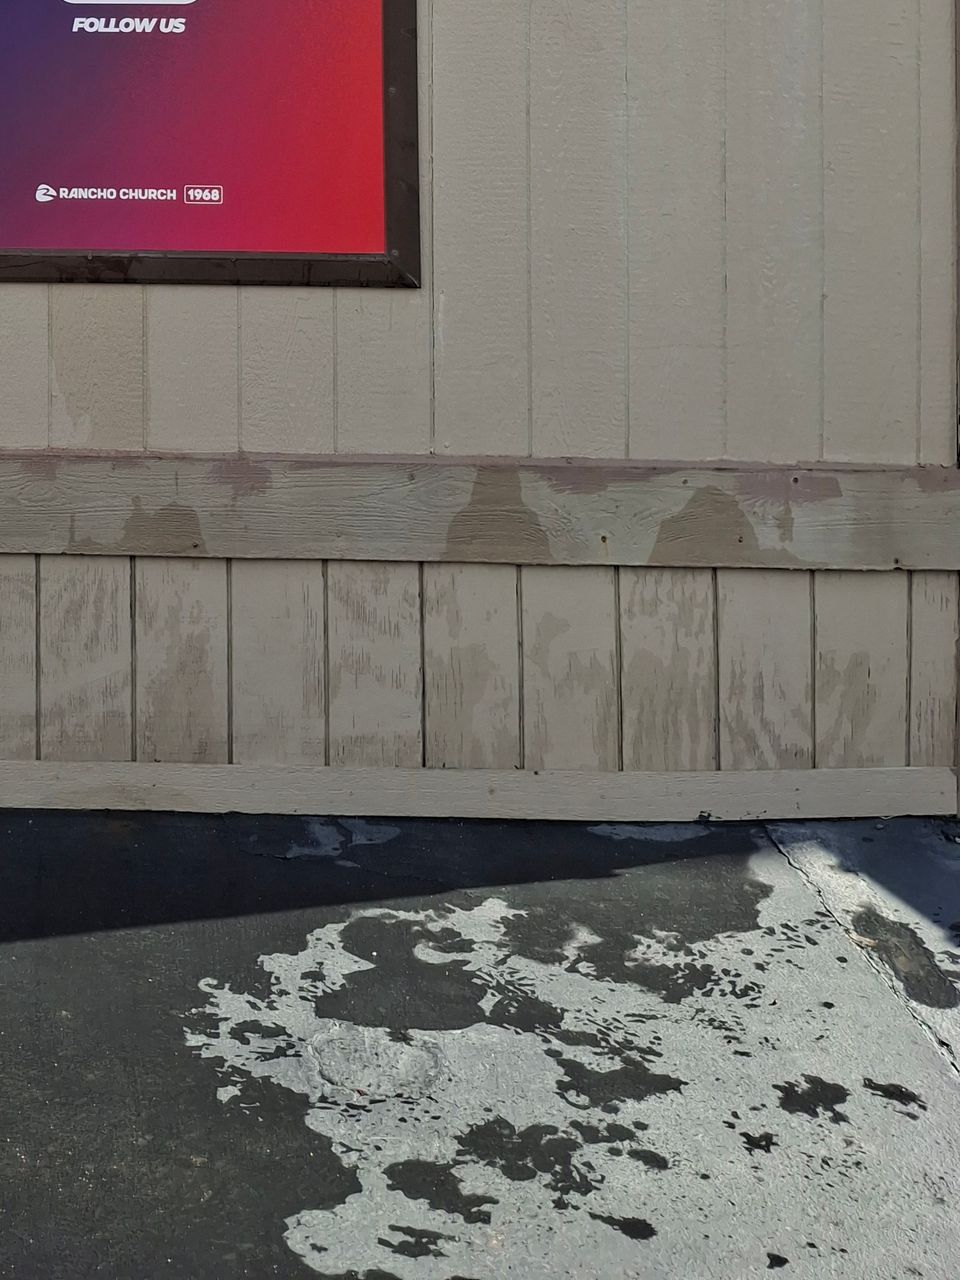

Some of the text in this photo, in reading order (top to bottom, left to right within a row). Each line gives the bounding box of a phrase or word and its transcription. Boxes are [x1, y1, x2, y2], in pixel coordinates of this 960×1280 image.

[71, 17, 186, 34] FOLLOW US
[58, 186, 220, 202] RANCHO CHURCH 1968
